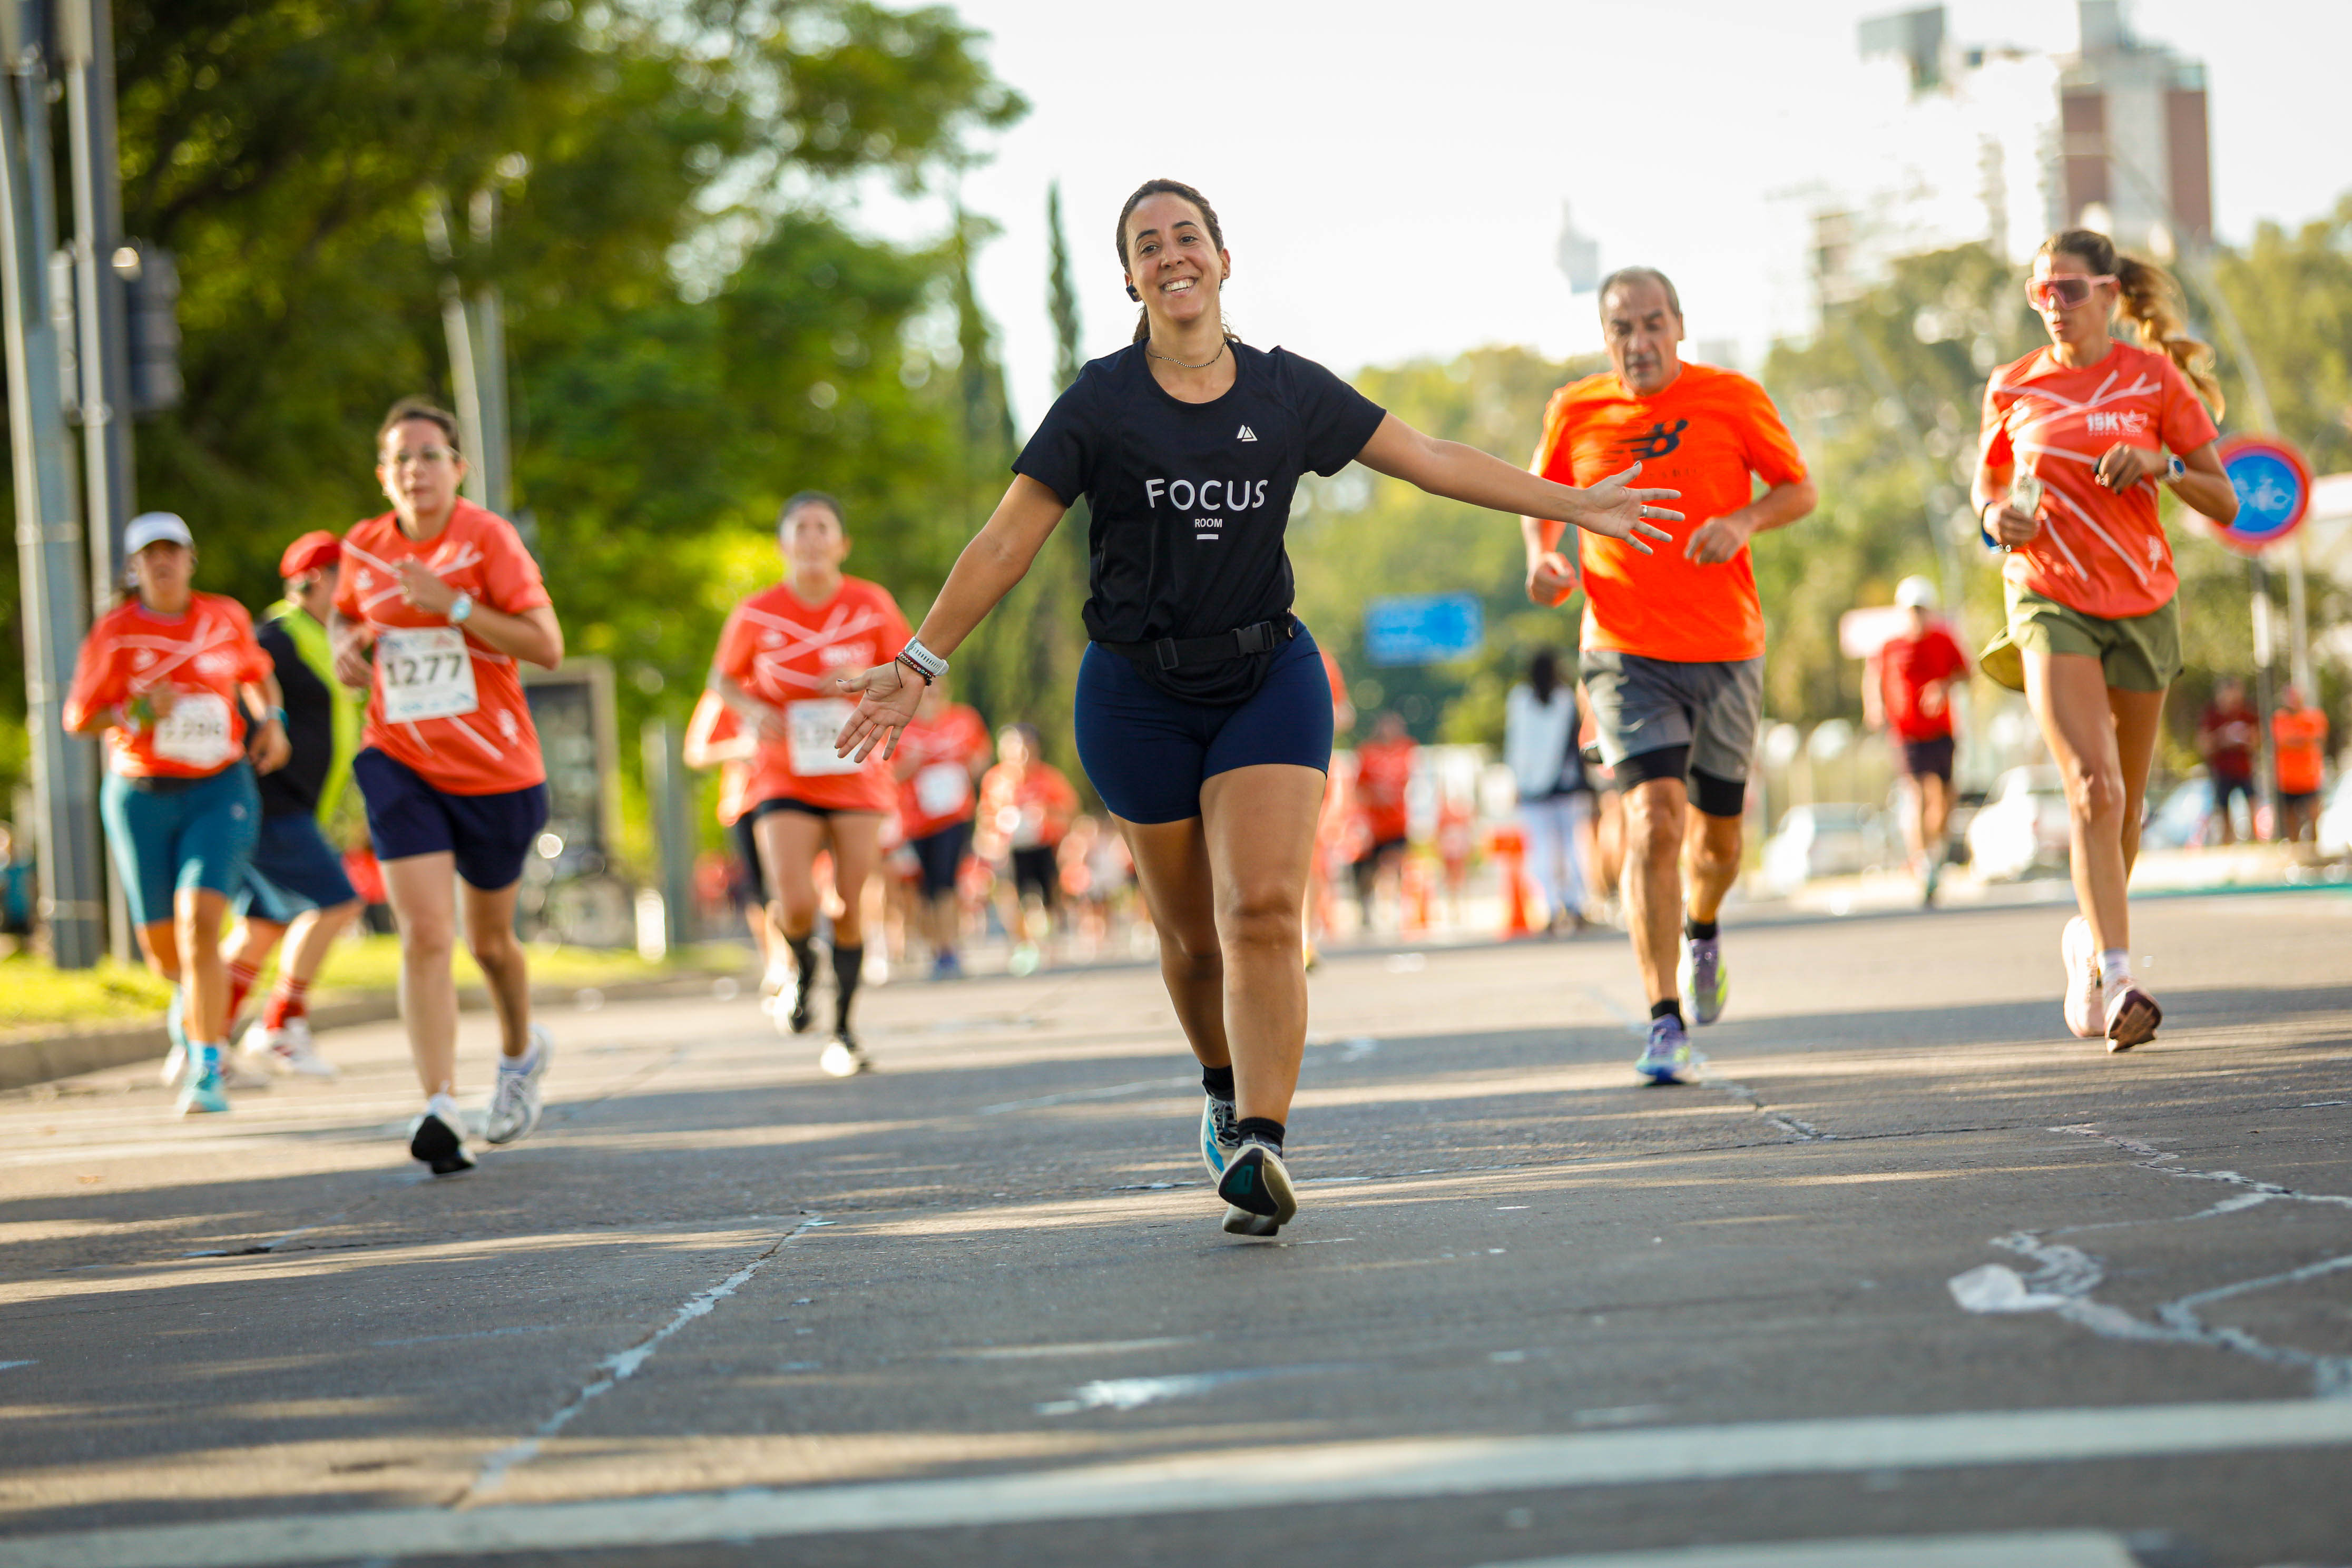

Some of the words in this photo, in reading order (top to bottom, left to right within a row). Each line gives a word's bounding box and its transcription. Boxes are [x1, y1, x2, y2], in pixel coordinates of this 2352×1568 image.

[1145, 478, 1269, 512] FOCUS
[1194, 518, 1223, 528] ROOM
[386, 653, 463, 687] 1277
